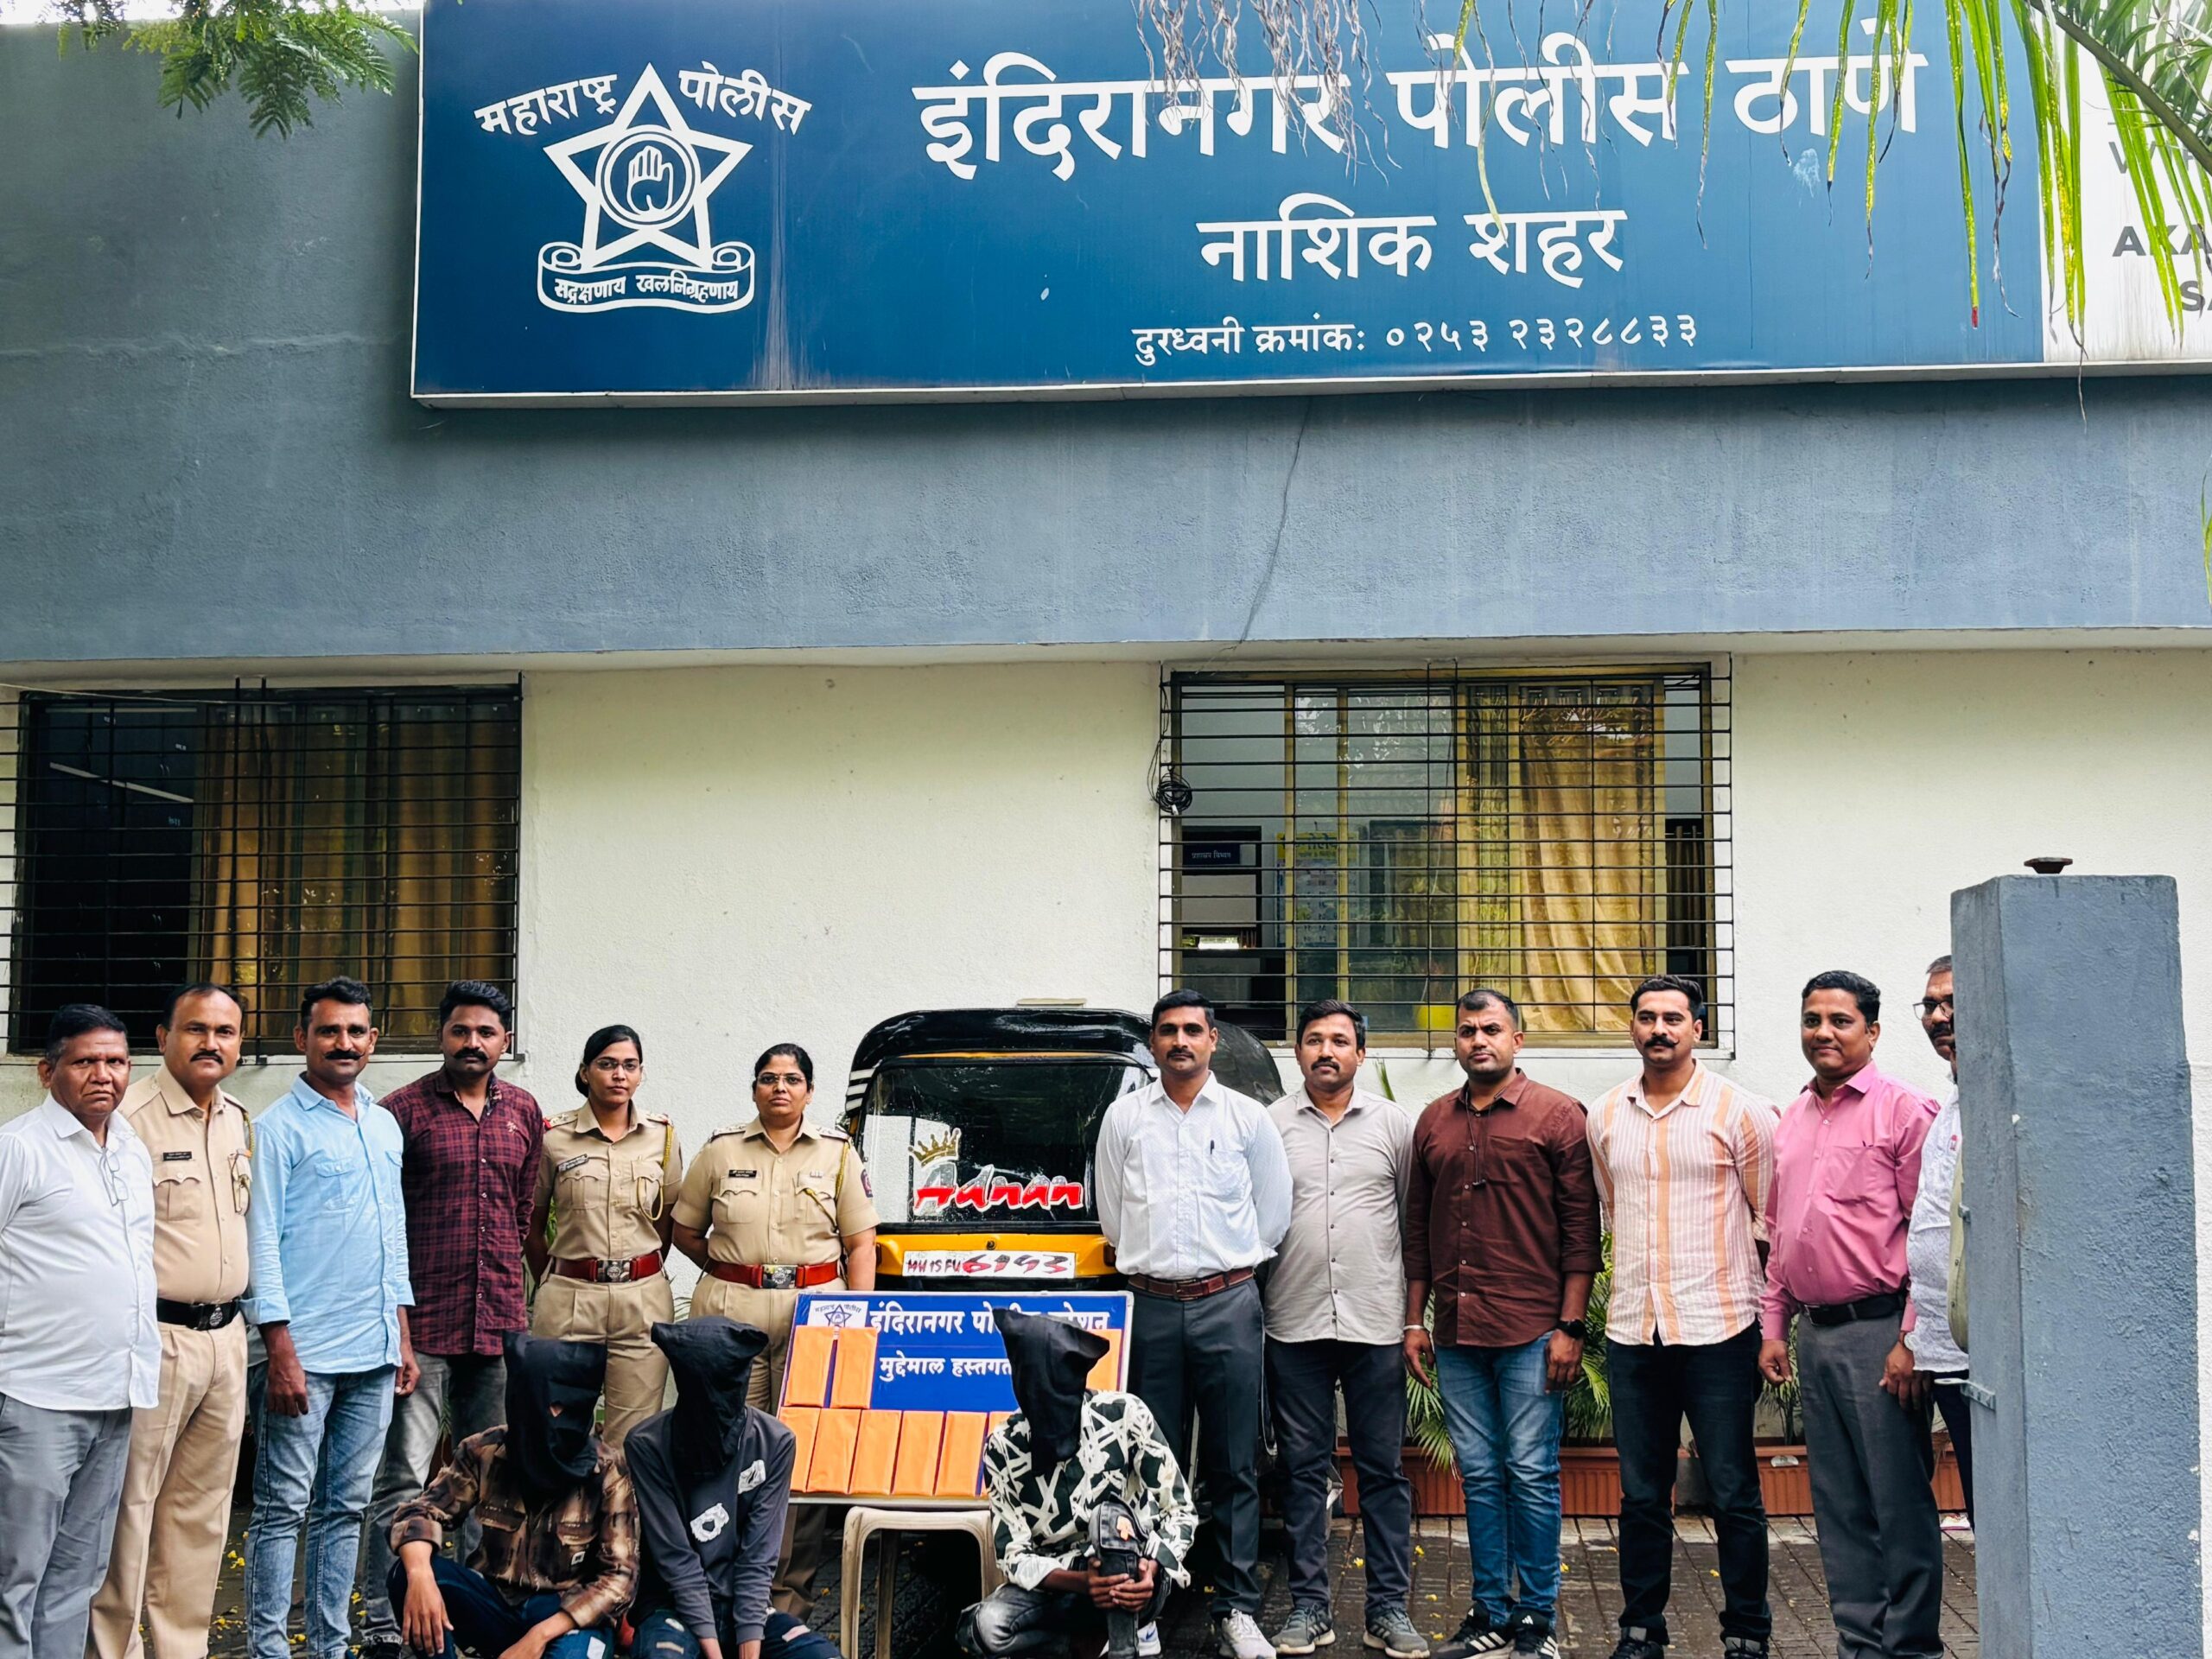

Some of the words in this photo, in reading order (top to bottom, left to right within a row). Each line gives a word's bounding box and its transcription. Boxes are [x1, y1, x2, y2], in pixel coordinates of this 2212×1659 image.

[474, 73, 618, 136] महाराष्ट्र
[678, 60, 812, 136] पोलीस
[912, 51, 1352, 181] इंदिरानगर
[1385, 32, 1690, 149] पोलीस
[1726, 17, 1929, 137] ठाणे
[1195, 192, 1438, 283] नाशिक
[1463, 210, 1629, 289] शहर
[635, 270, 739, 303] खलनिग्रहणाय
[1386, 320, 1489, 353] ०२५३
[1508, 314, 1697, 351] २३२८८३३
[914, 1163, 1083, 1211] Adnan
[879, 1350, 945, 1382] मुद्देमाल
